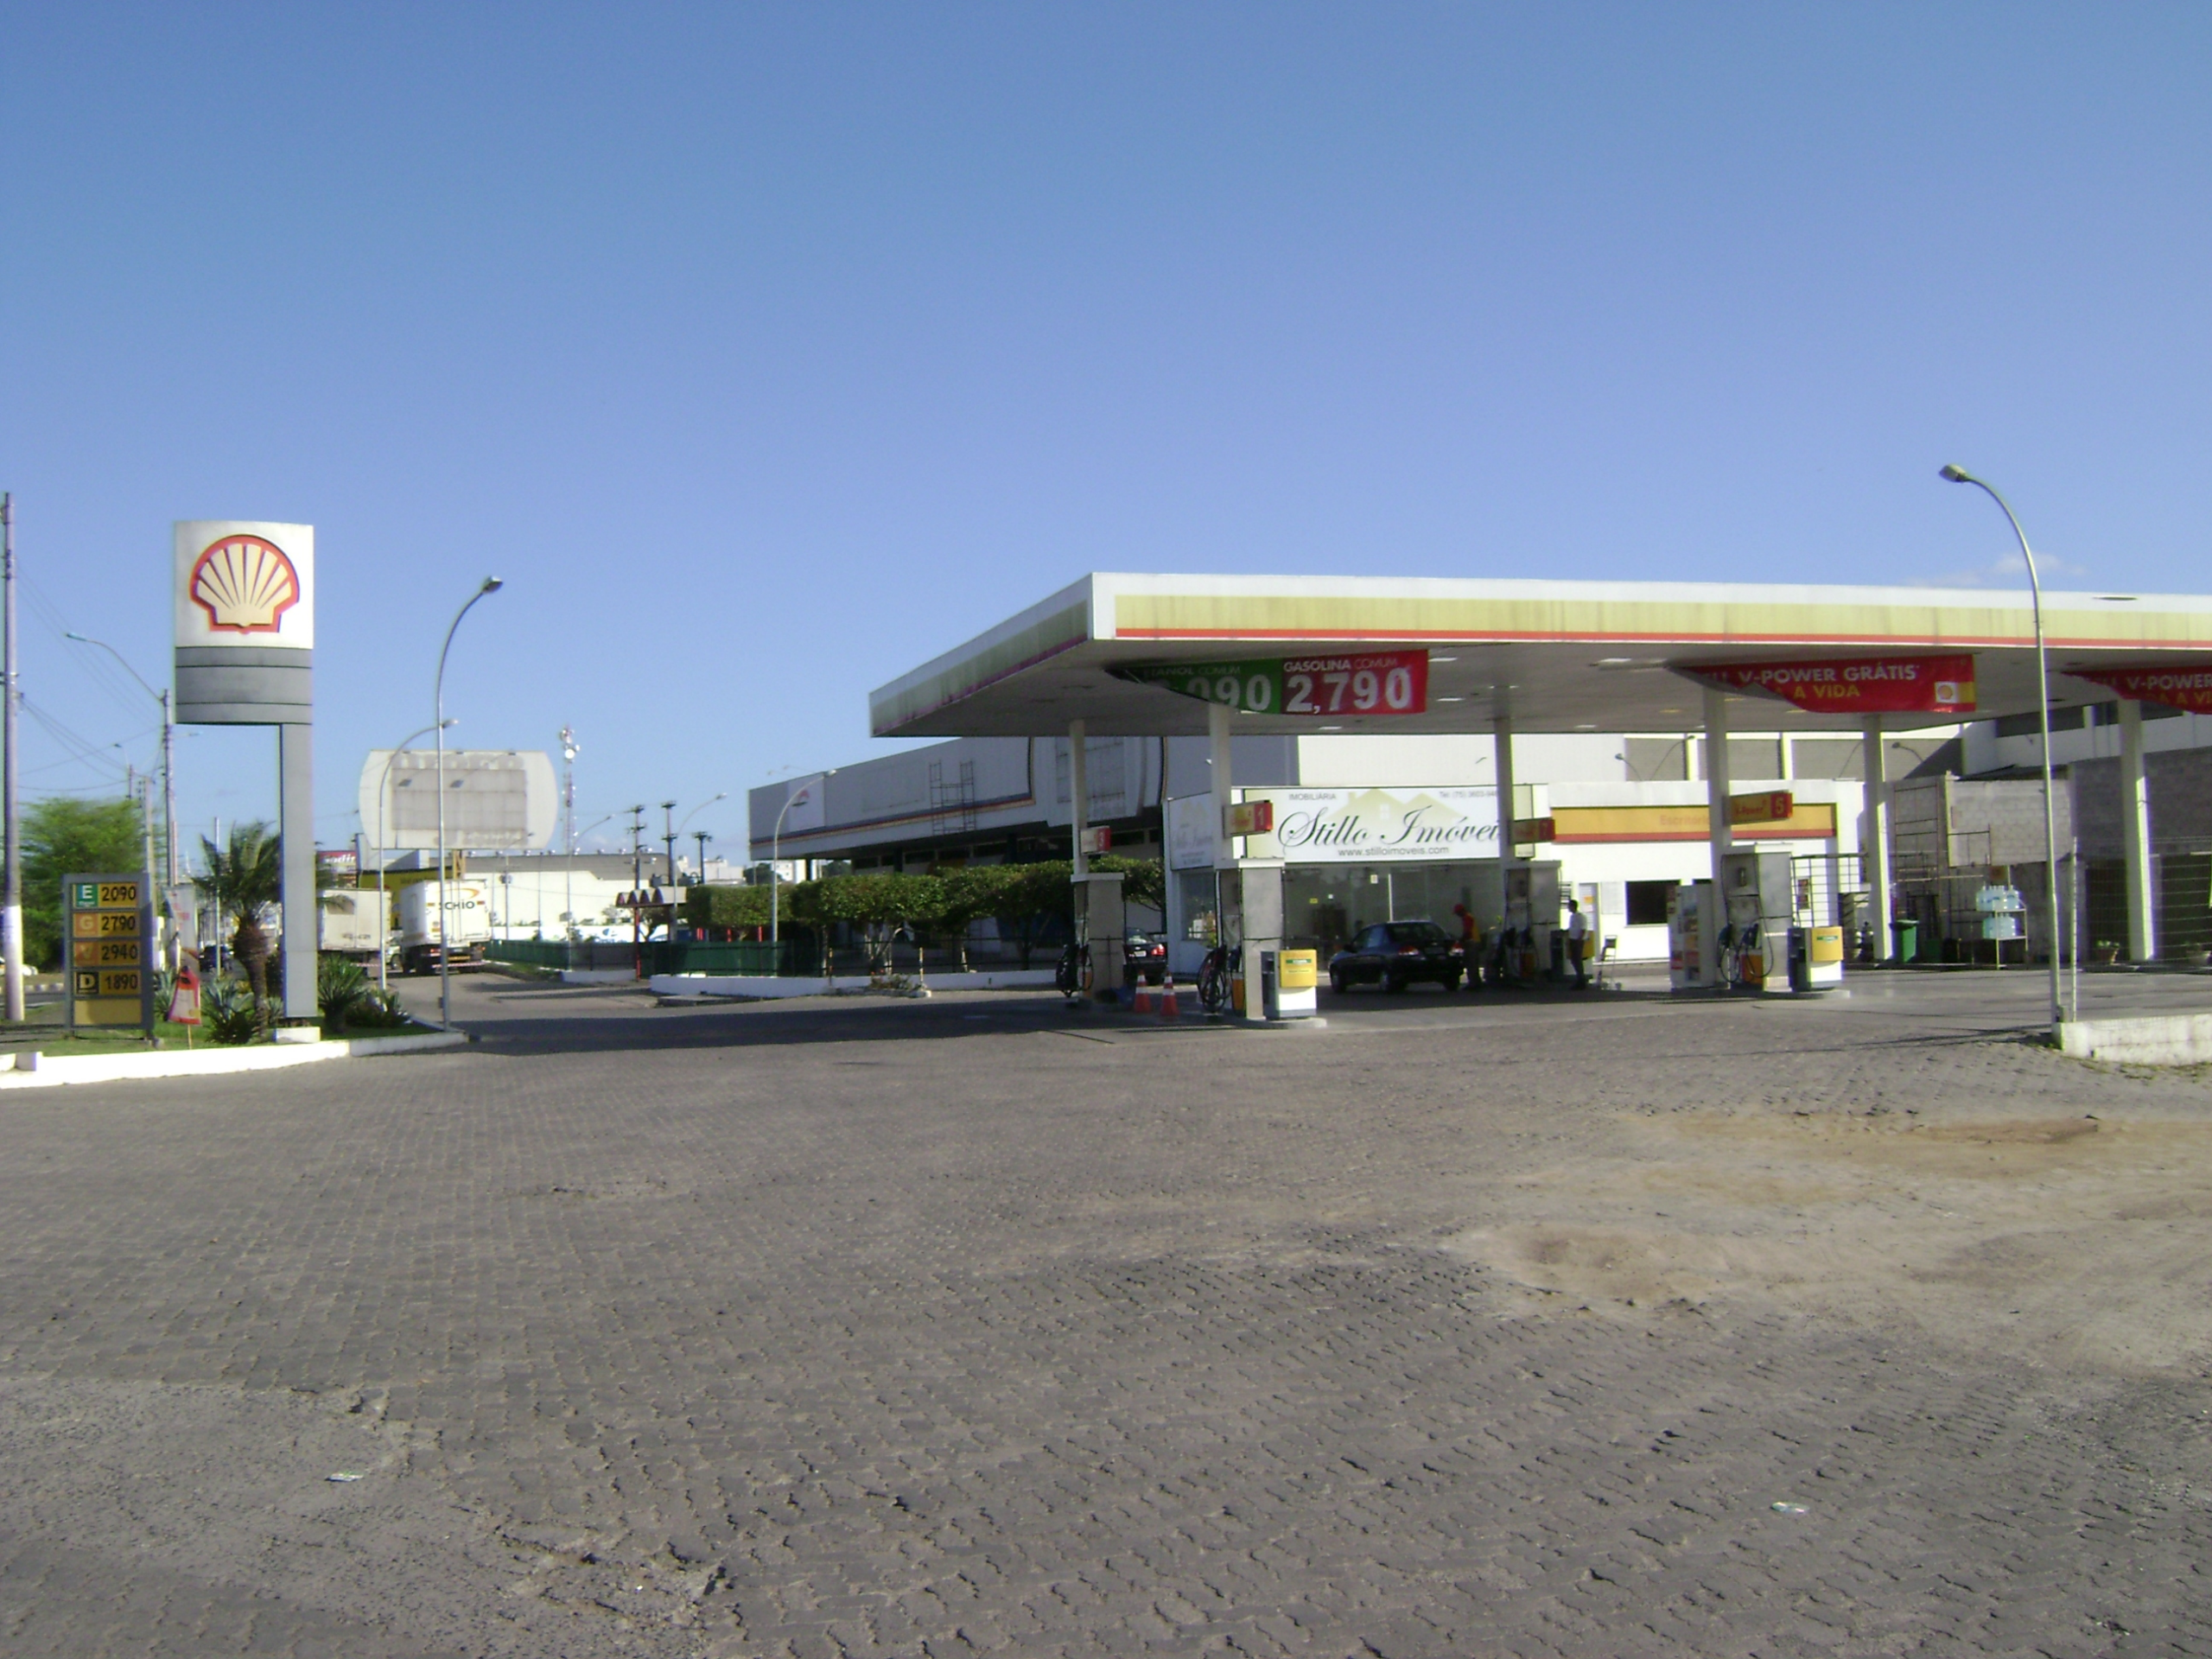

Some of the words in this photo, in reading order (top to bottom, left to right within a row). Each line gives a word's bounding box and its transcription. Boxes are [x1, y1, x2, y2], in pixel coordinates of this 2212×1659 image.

[1283, 659, 1351, 672] GASOLINA
[1354, 658, 1398, 669] COMUM
[1738, 667, 1836, 683] V-POWER
[1286, 667, 1413, 714] 2,790
[1814, 685, 1860, 699] VIDA
[1277, 806, 1370, 856] Stillo
[1379, 805, 1501, 846] Imóvei
[1338, 847, 1449, 856] www.stilloimoveis.com
[82, 885, 92, 899] E
[101, 887, 137, 901] 2090
[101, 917, 136, 931] 2790
[101, 945, 138, 961] 2940
[79, 975, 96, 988] D
[105, 975, 138, 990] 1890
